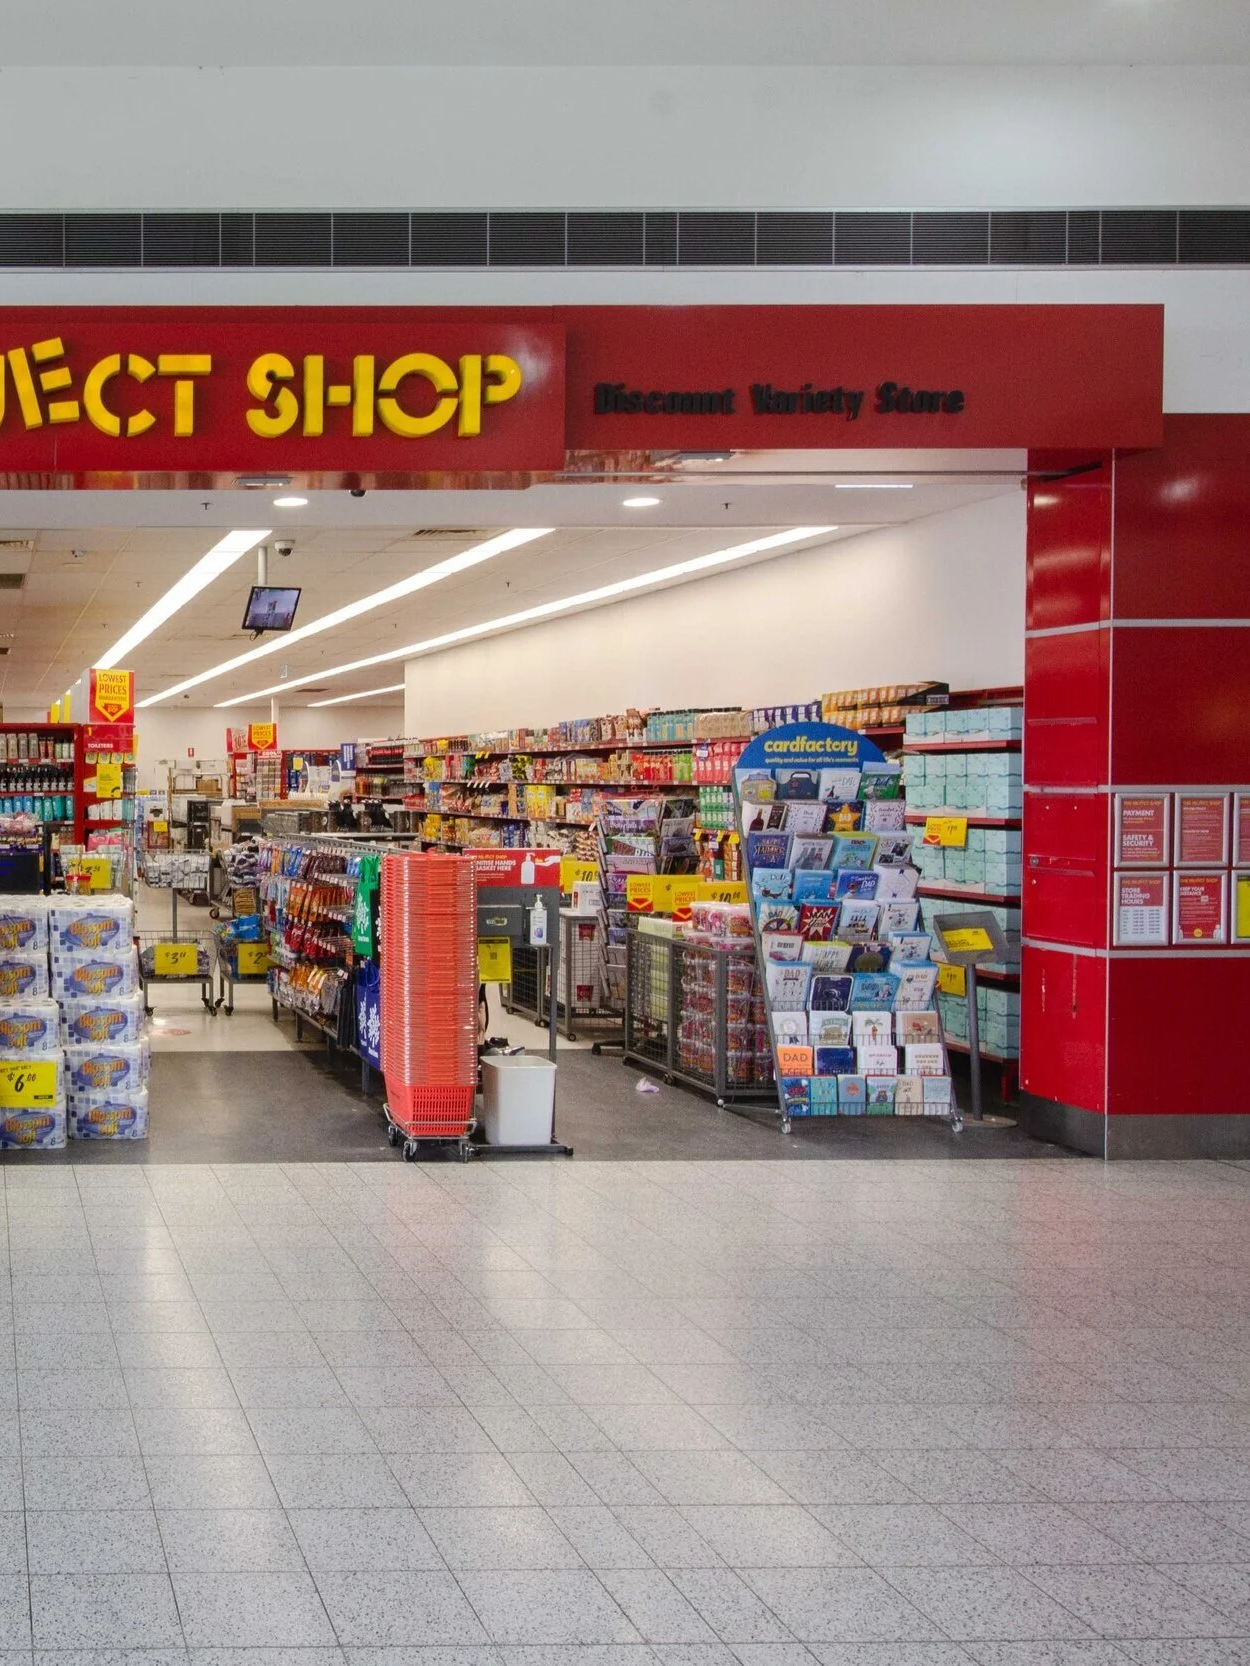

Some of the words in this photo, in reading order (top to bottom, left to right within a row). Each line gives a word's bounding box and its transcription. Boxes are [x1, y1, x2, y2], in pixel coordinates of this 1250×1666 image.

[245, 351, 524, 439] SHOP
[594, 383, 735, 416] Discount
[752, 383, 865, 421] Variety
[875, 381, 966, 415] Store
[99, 674, 126, 683] LOWEST
[99, 684, 127, 694] PRICES
[764, 736, 858, 756] cardfactory
[861, 881, 876, 889] DAD
[810, 911, 832, 919] MAN
[70, 918, 114, 935] Blossom
[0, 934, 19, 952] Soft
[82, 932, 102, 948] Soft
[76, 966, 118, 981] Blossom
[784, 970, 800, 978] DAD
[0, 979, 19, 997] Soft
[87, 978, 106, 996] Soft
[79, 1013, 122, 1029] Blossom
[8, 1033, 28, 1050] Soft
[90, 1027, 109, 1043] Soft
[783, 1053, 808, 1062] DAD
[83, 1061, 126, 1078] Blossom
[93, 1074, 111, 1089] Soft
[6, 1114, 51, 1132] Blossom
[89, 1110, 132, 1127] Blossom
[17, 1128, 38, 1144] Soft
[101, 1123, 119, 1137] Soft
